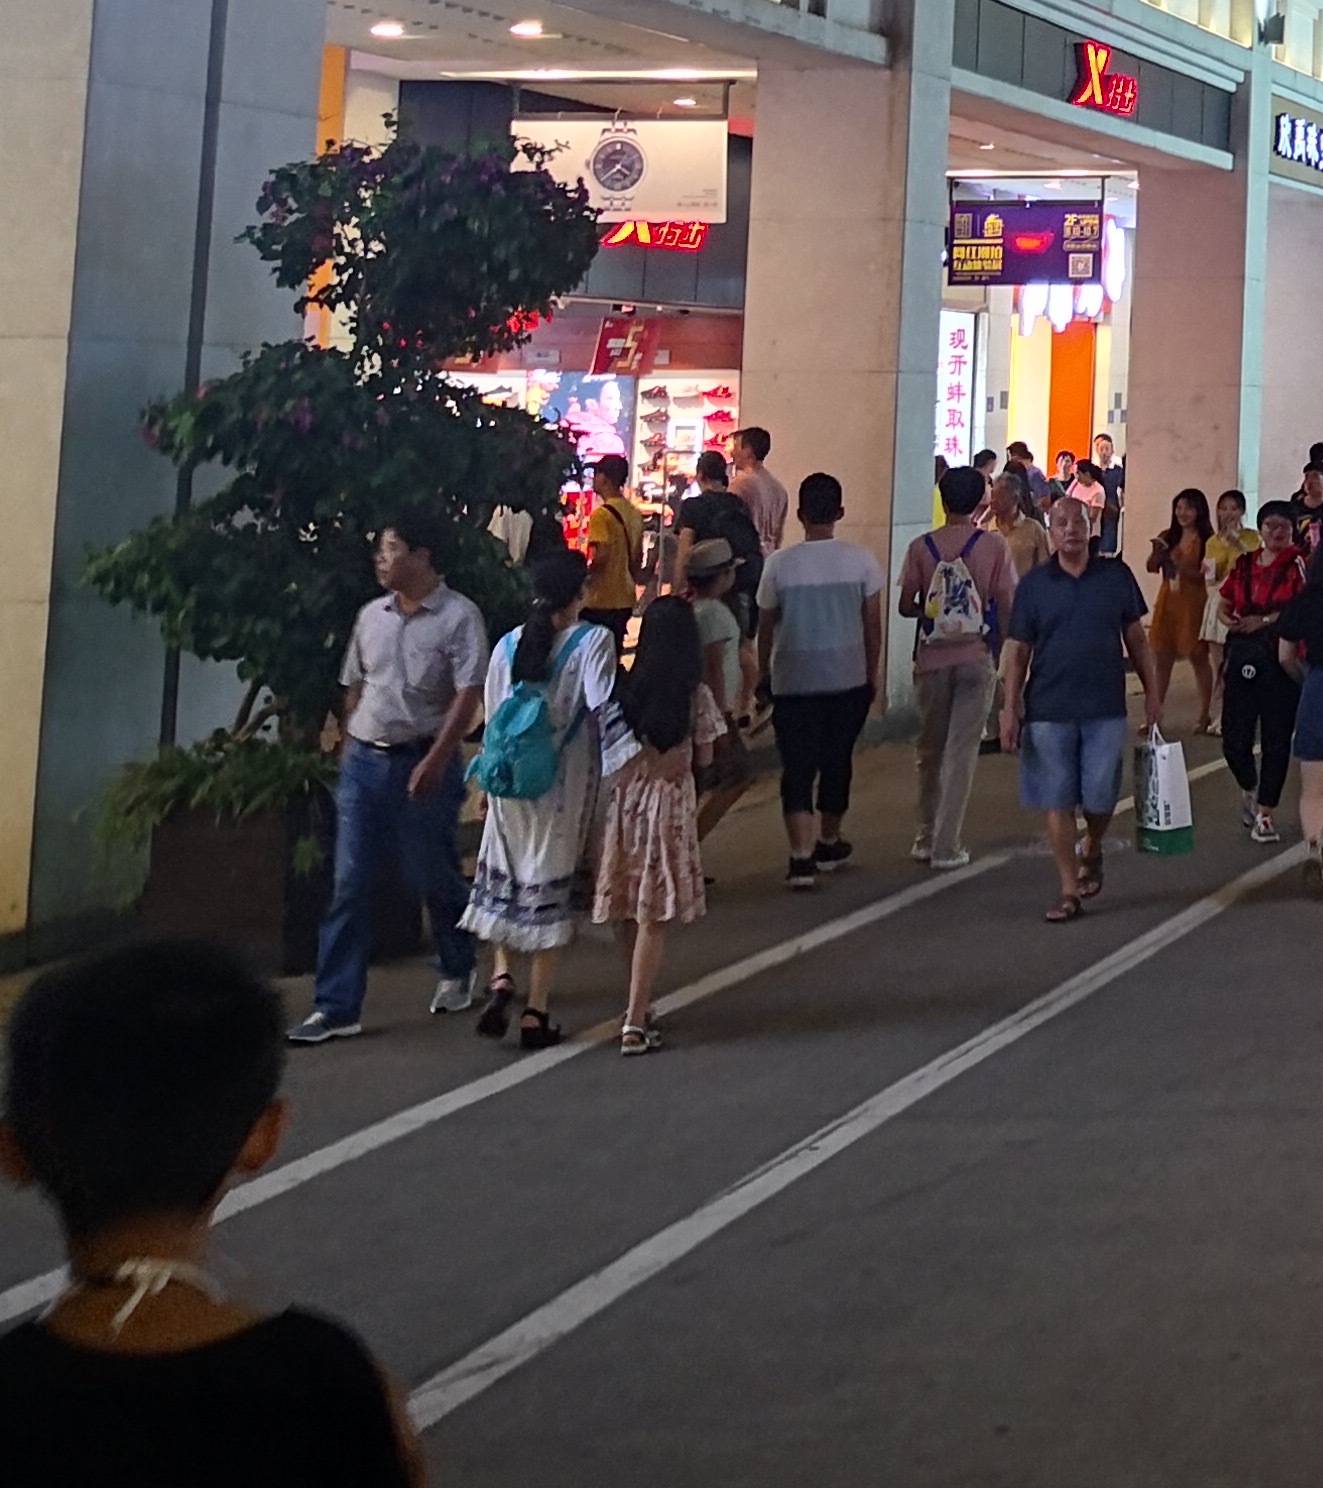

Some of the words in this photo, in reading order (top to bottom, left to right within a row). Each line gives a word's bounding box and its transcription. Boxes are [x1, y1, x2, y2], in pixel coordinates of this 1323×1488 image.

[944, 328, 969, 457] 现开蚌取珠
